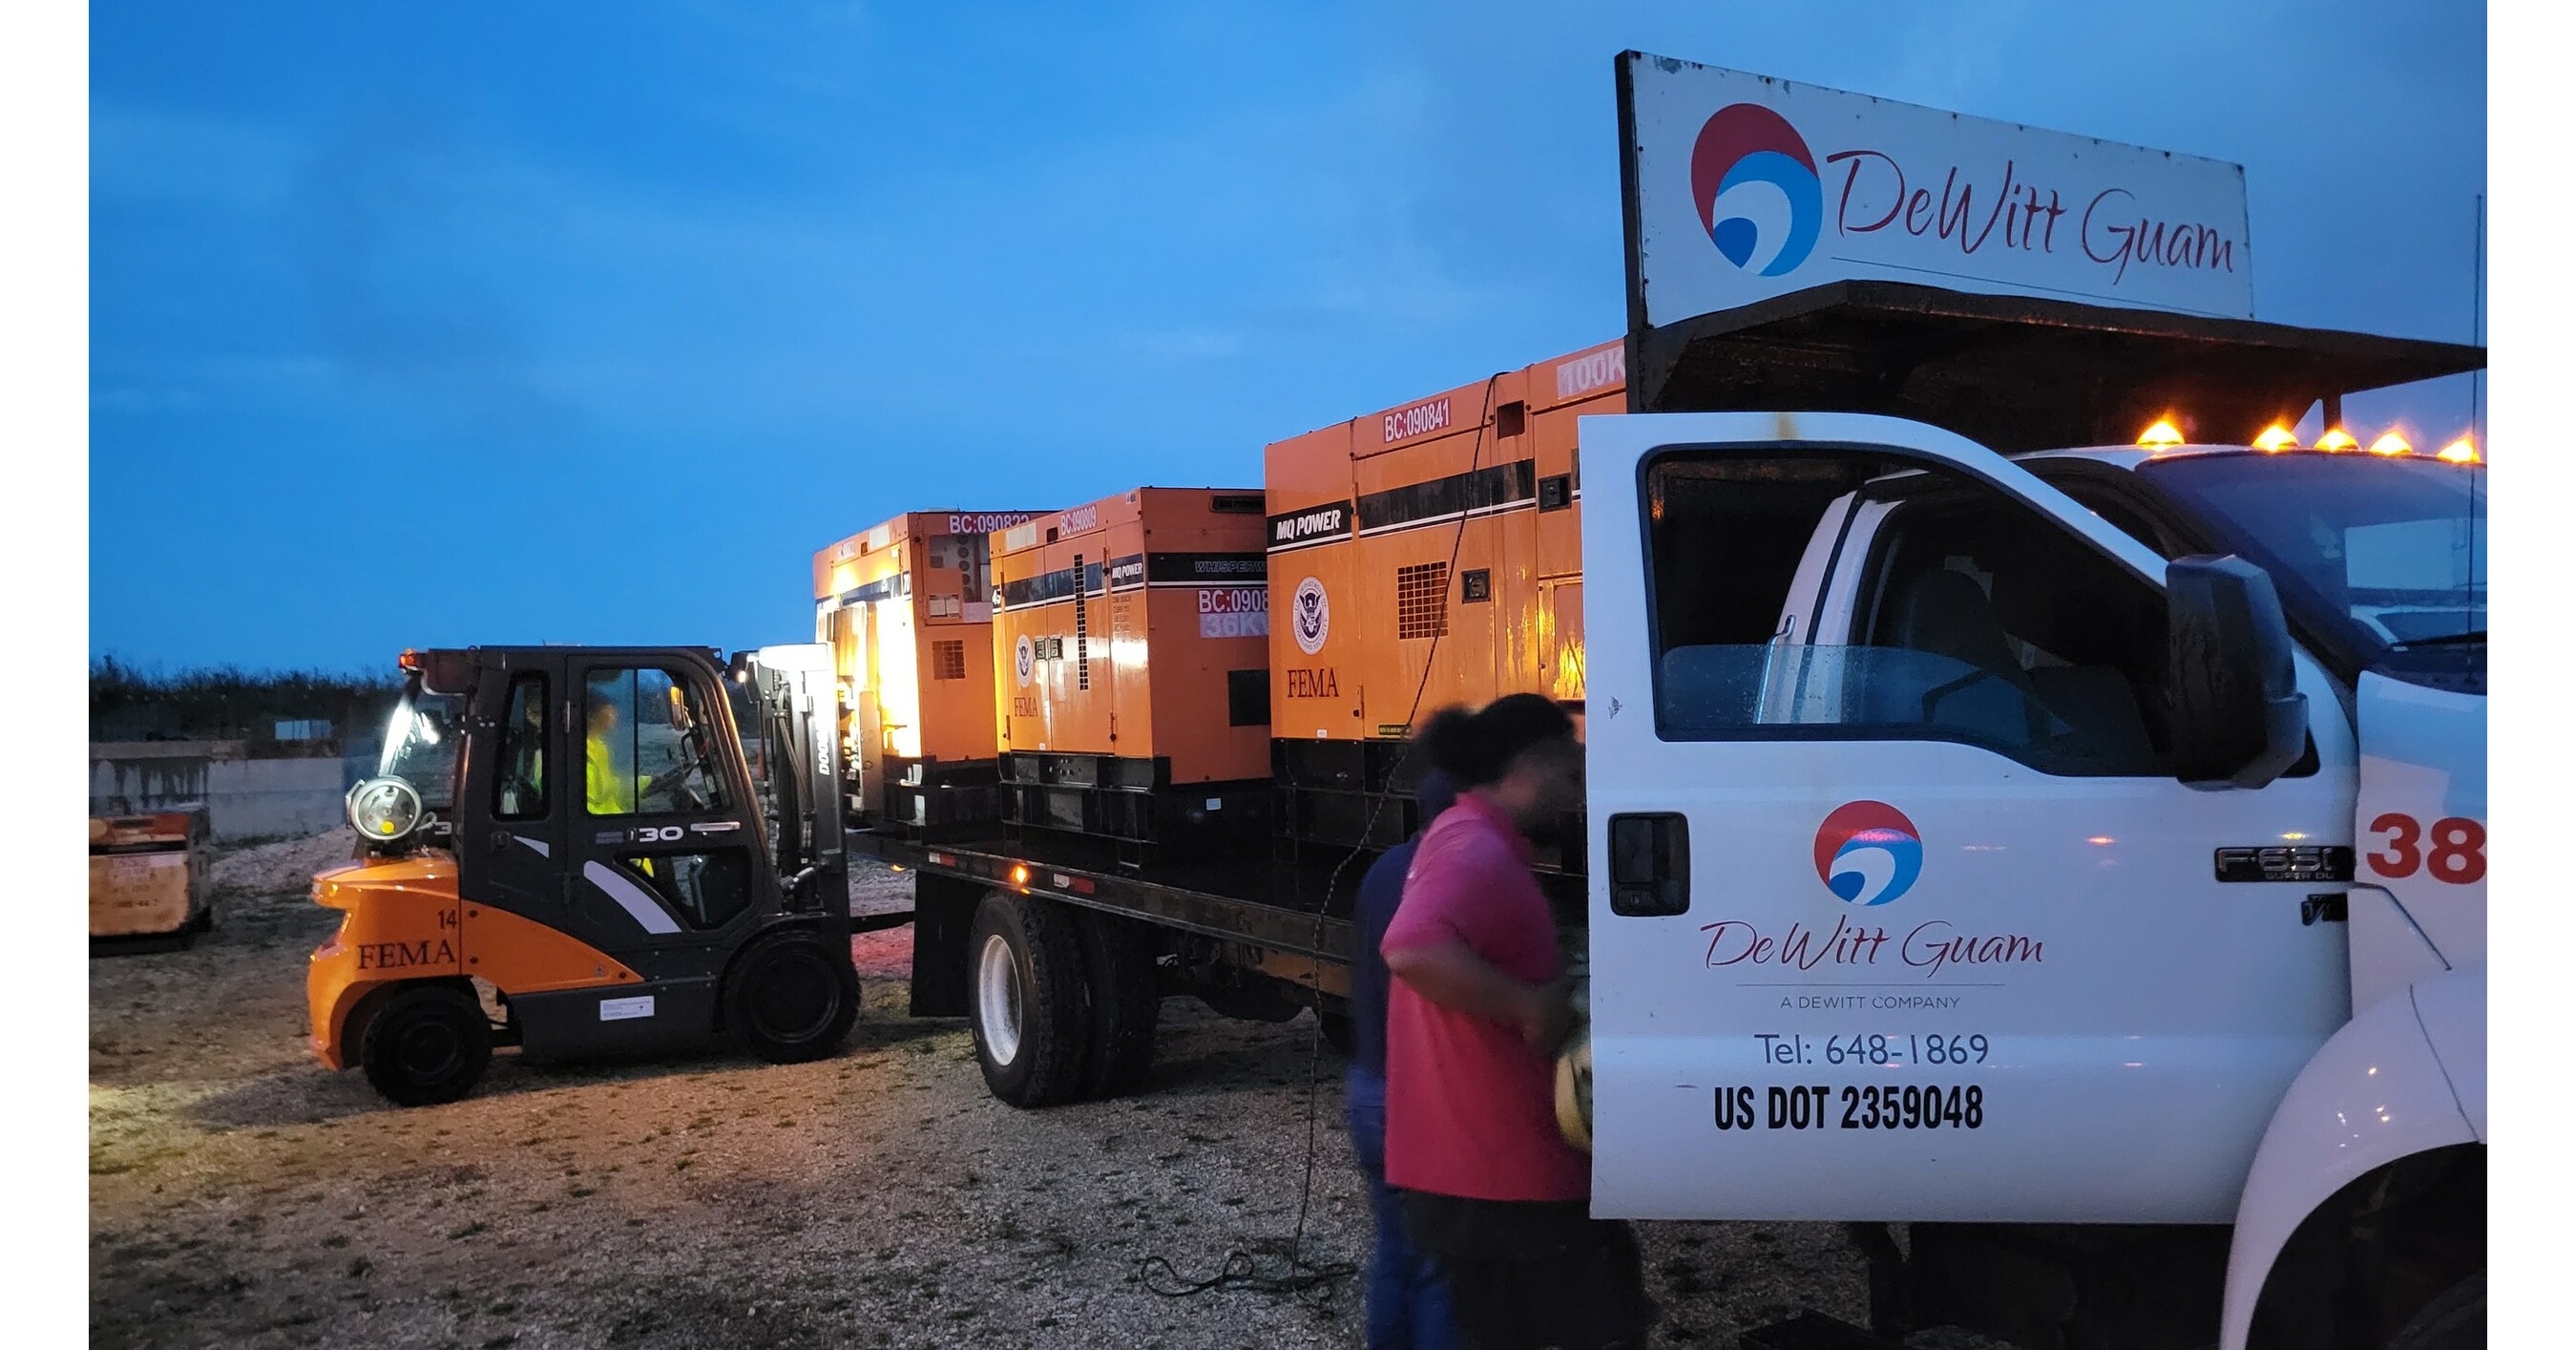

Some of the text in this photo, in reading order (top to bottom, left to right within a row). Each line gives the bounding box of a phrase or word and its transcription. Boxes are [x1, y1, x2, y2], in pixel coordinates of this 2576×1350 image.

[1826, 150, 2233, 285] DeWitt Guam
[1384, 398, 1450, 443] BC:090841
[1276, 509, 1341, 540] MQ POWER
[1111, 562, 1142, 580] MQ POWER
[1287, 667, 1339, 698] FEMA
[1014, 697, 1038, 717] FEMA
[639, 826, 683, 843] 30
[2366, 812, 2486, 884] 38
[438, 910, 458, 930] 14
[358, 939, 456, 970] FEMA
[1700, 914, 2044, 979] DeWitt Guam
[1780, 996, 1960, 1009] A DEWITT COMPANY
[1754, 1033, 1989, 1065] Tel: 648-1869
[1714, 1085, 1983, 1129] US DOT 2359048
